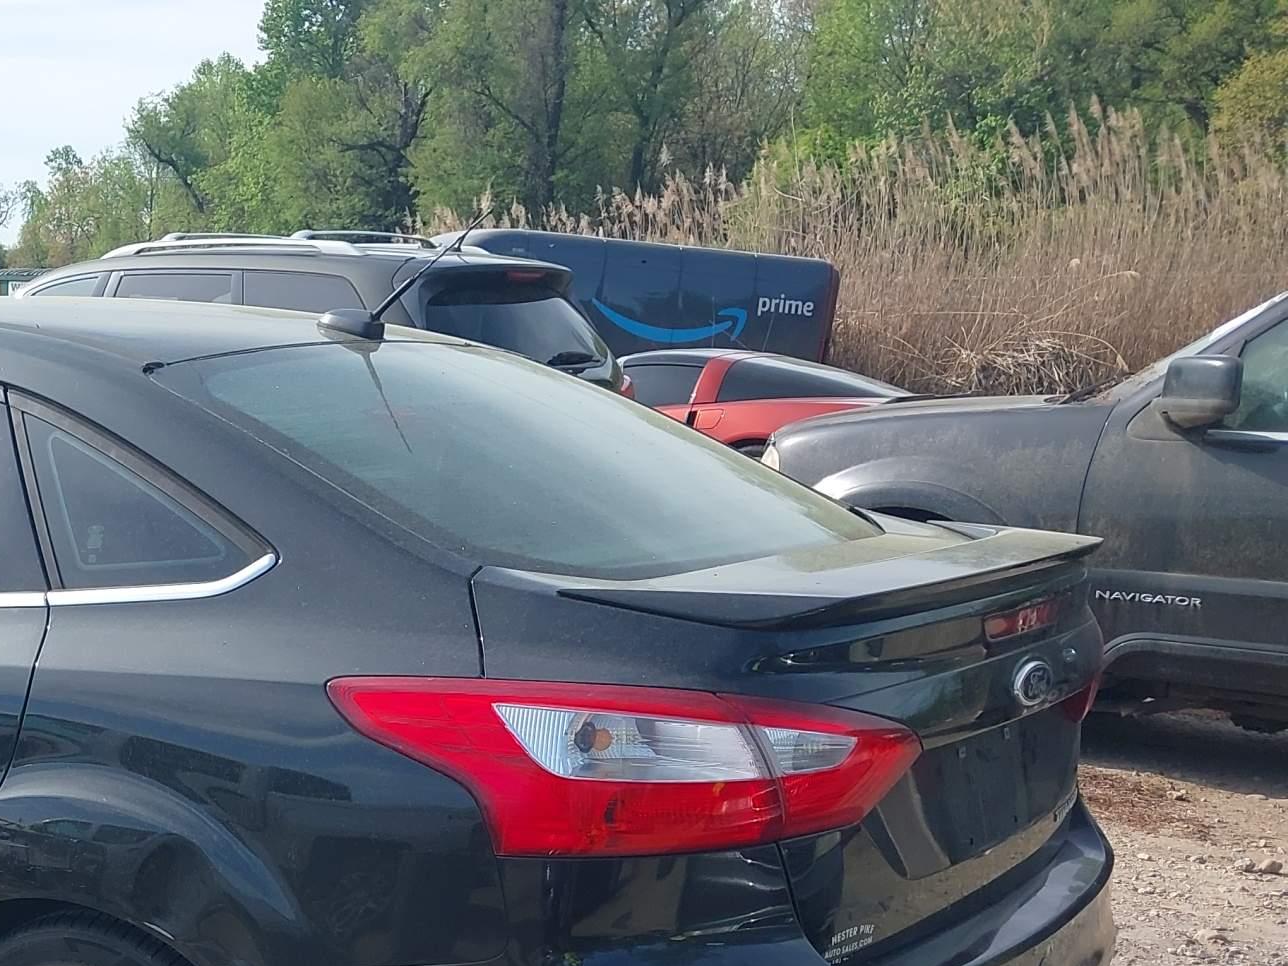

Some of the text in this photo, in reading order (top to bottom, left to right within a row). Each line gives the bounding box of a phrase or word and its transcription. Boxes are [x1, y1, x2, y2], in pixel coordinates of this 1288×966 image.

[757, 293, 814, 317] prime
[1095, 590, 1202, 607] NAVIGATOR
[824, 948, 841, 959] AUTO
